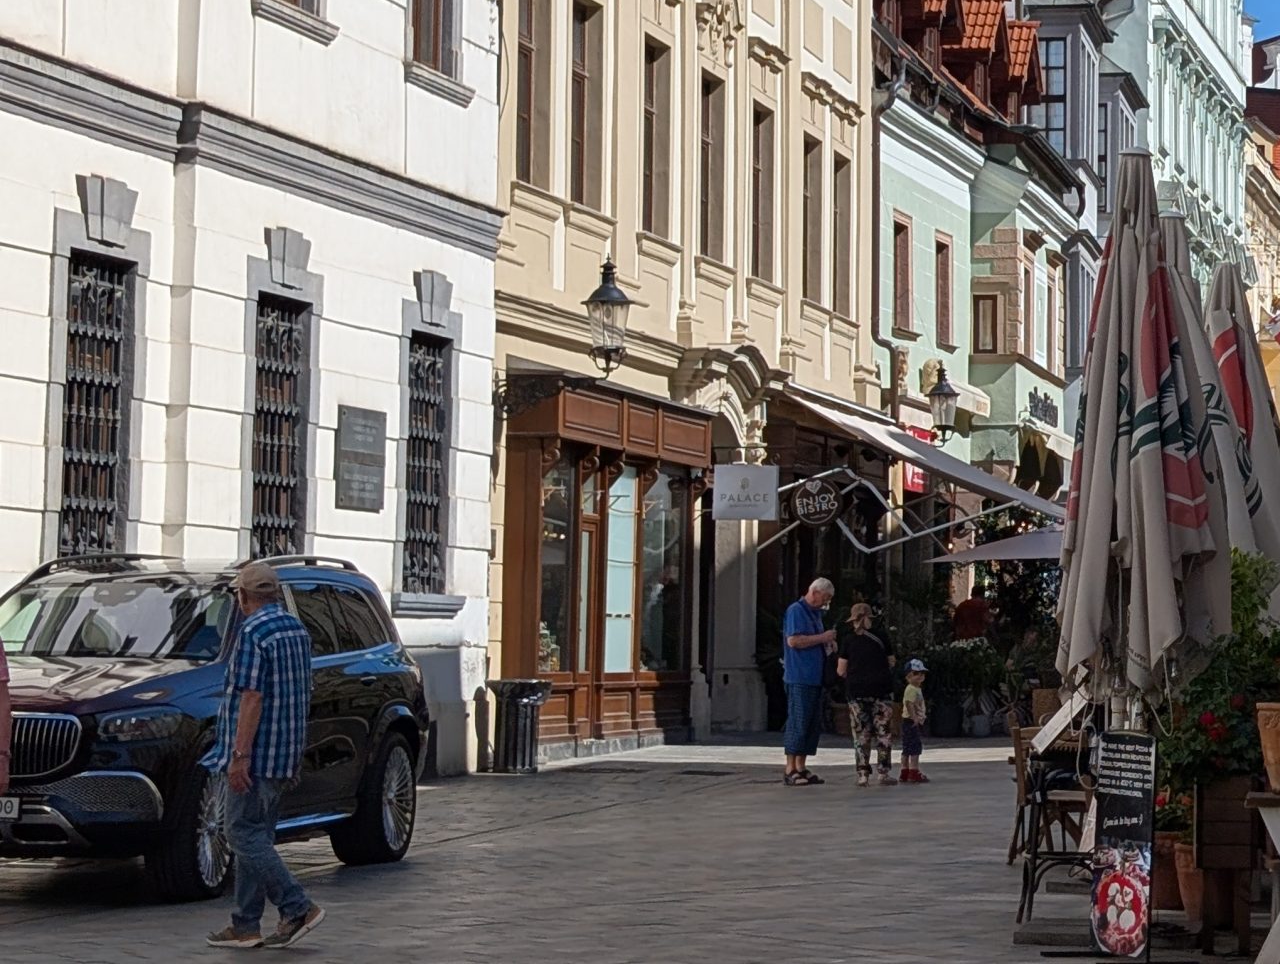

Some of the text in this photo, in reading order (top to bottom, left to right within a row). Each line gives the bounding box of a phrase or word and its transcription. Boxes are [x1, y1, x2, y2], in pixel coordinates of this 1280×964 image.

[720, 493, 769, 502] PALACE
[796, 493, 835, 507] ENJOY
[797, 501, 838, 515] BISTRO
